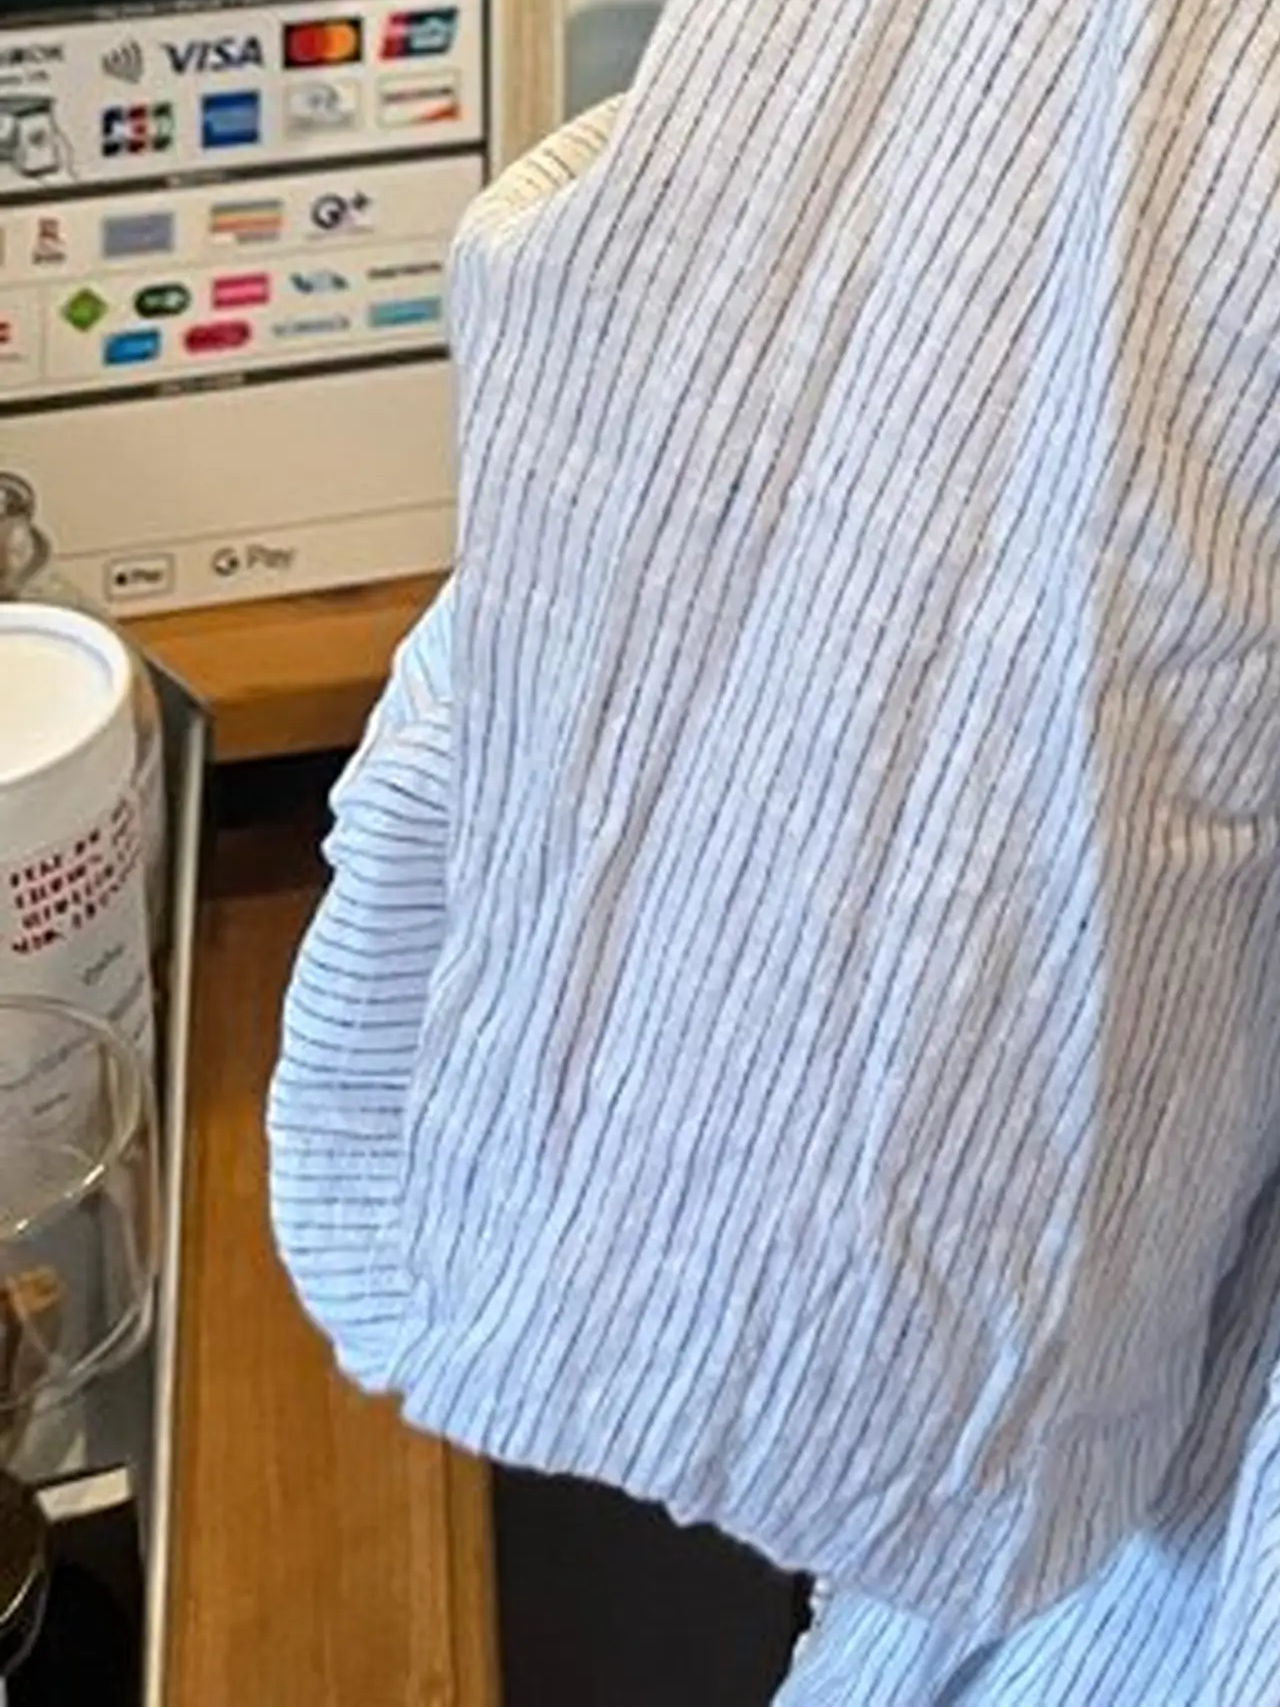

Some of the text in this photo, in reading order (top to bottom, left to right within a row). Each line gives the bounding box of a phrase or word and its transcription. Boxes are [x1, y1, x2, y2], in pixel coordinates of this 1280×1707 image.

[162, 36, 264, 75] VISA
[101, 101, 174, 158] JCB
[246, 543, 297, 570] Pay
